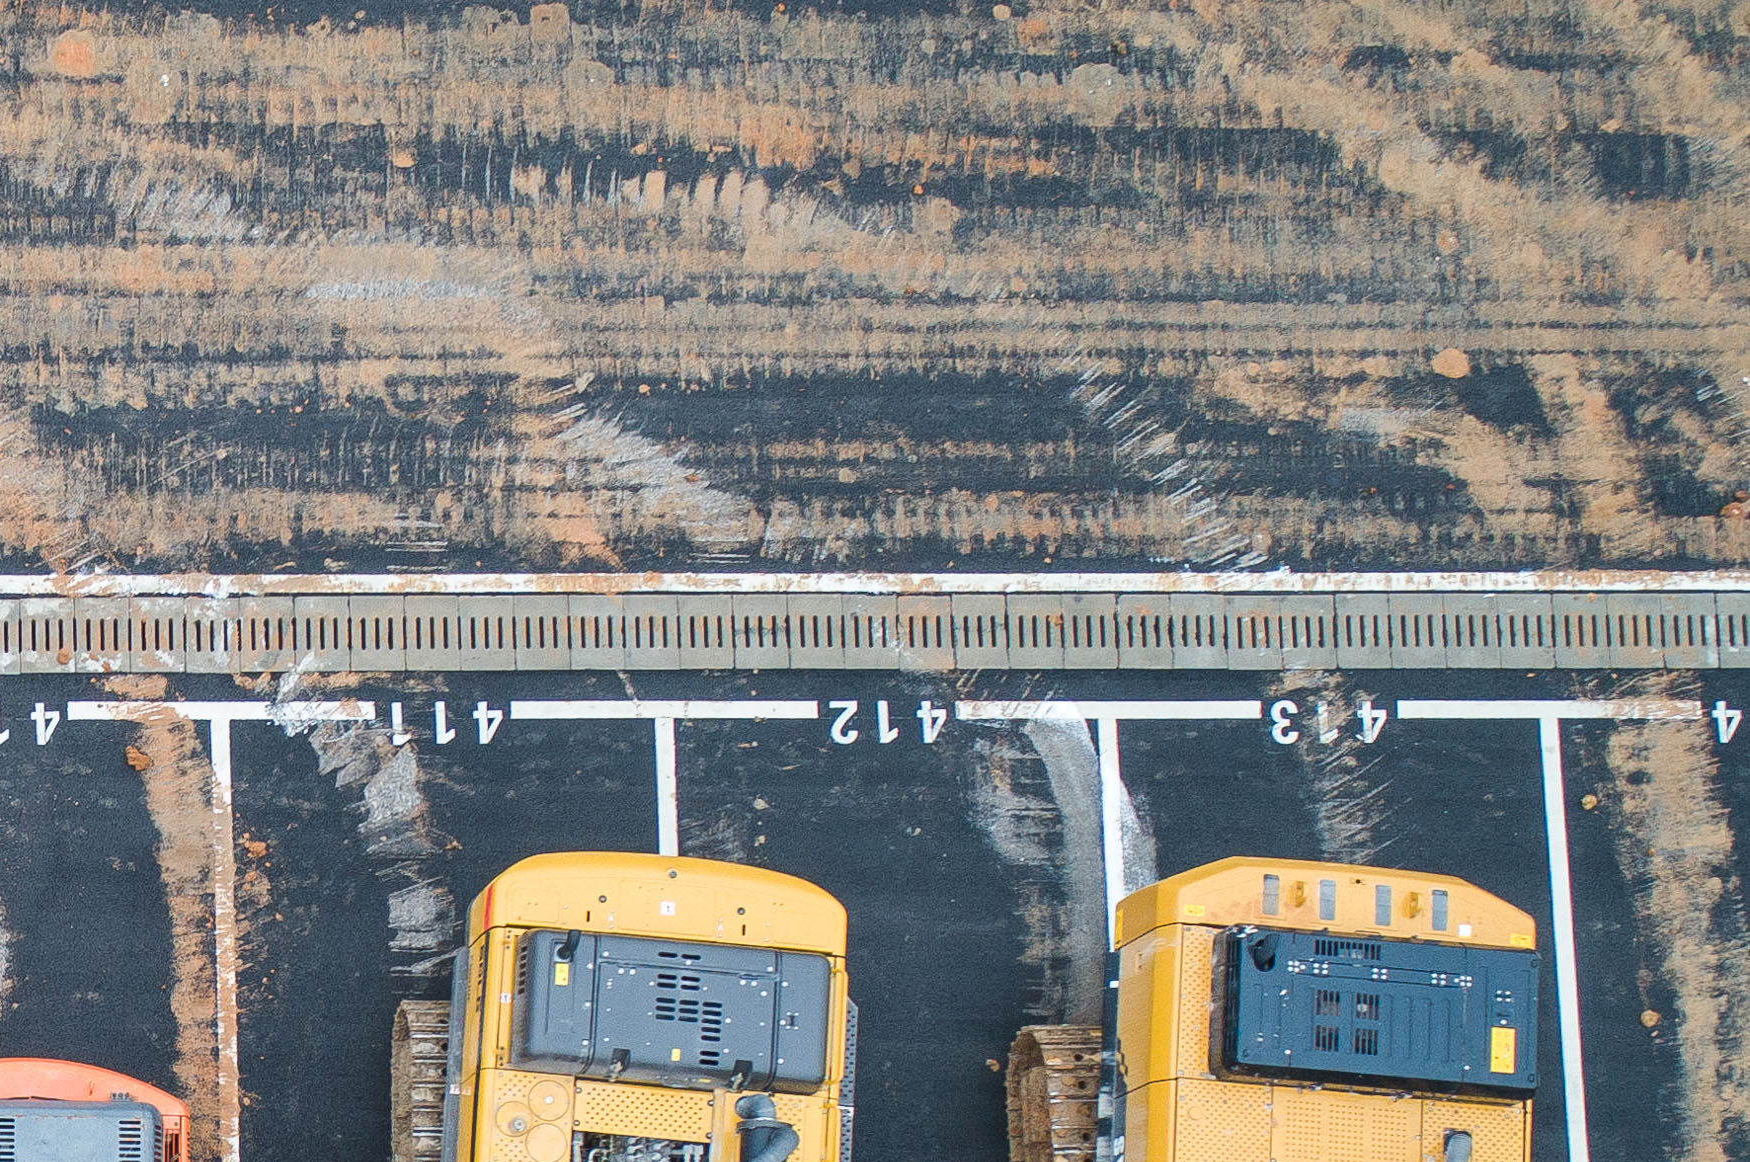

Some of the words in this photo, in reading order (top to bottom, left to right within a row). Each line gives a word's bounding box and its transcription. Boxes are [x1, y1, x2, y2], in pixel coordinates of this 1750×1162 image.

[391, 701, 504, 746] 411
[828, 700, 948, 745] 412
[1269, 700, 1388, 745] 413
